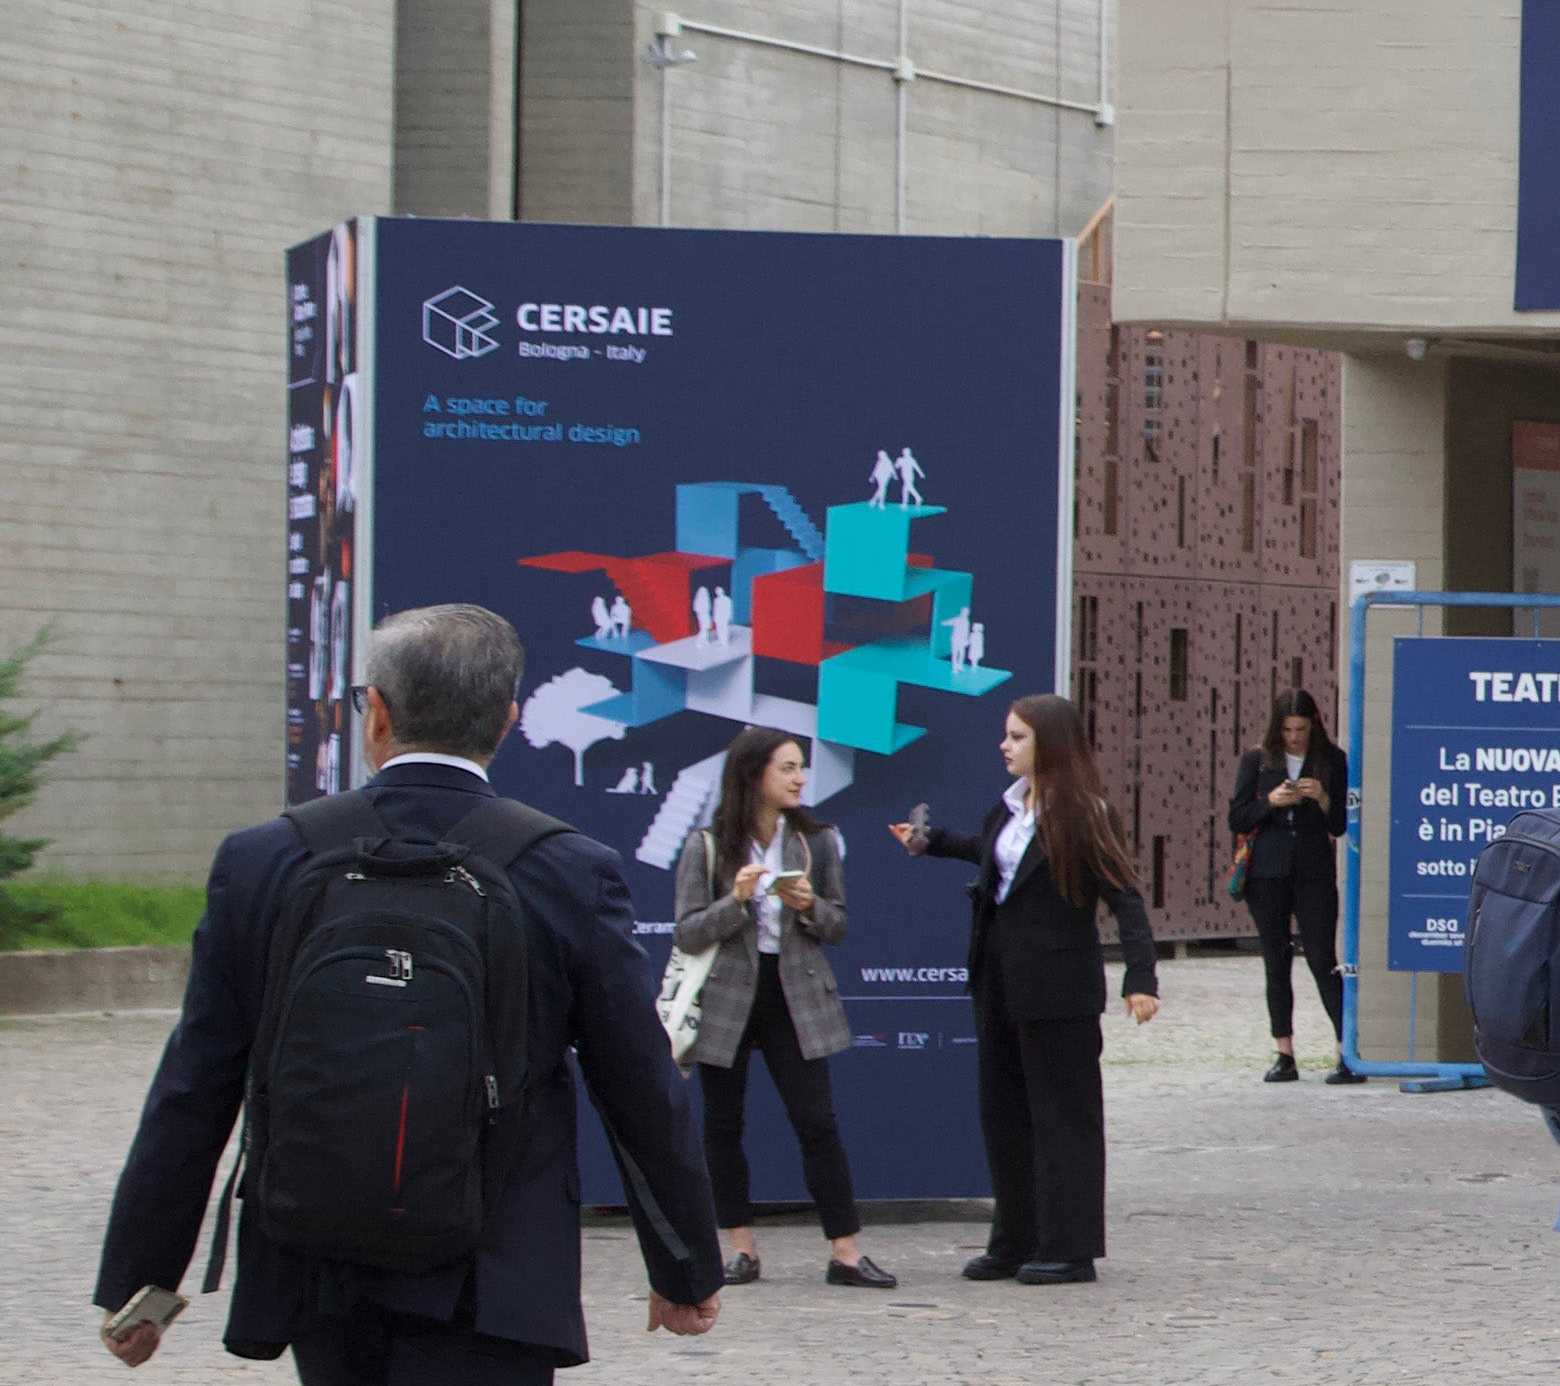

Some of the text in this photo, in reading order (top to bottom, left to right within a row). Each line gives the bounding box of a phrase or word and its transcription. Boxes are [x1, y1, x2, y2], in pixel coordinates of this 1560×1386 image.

[517, 303, 673, 335] CERSAIE
[519, 341, 589, 361] Bologna
[607, 345, 645, 363] Italy
[422, 393, 549, 416] A space for
[423, 420, 640, 447] architectural design
[1440, 748, 1470, 771] La
[1420, 783, 1458, 807] del
[1465, 784, 1545, 808] Teatro
[1419, 818, 1433, 841] è
[1440, 819, 1461, 841] in
[1417, 860, 1466, 876] sotto
